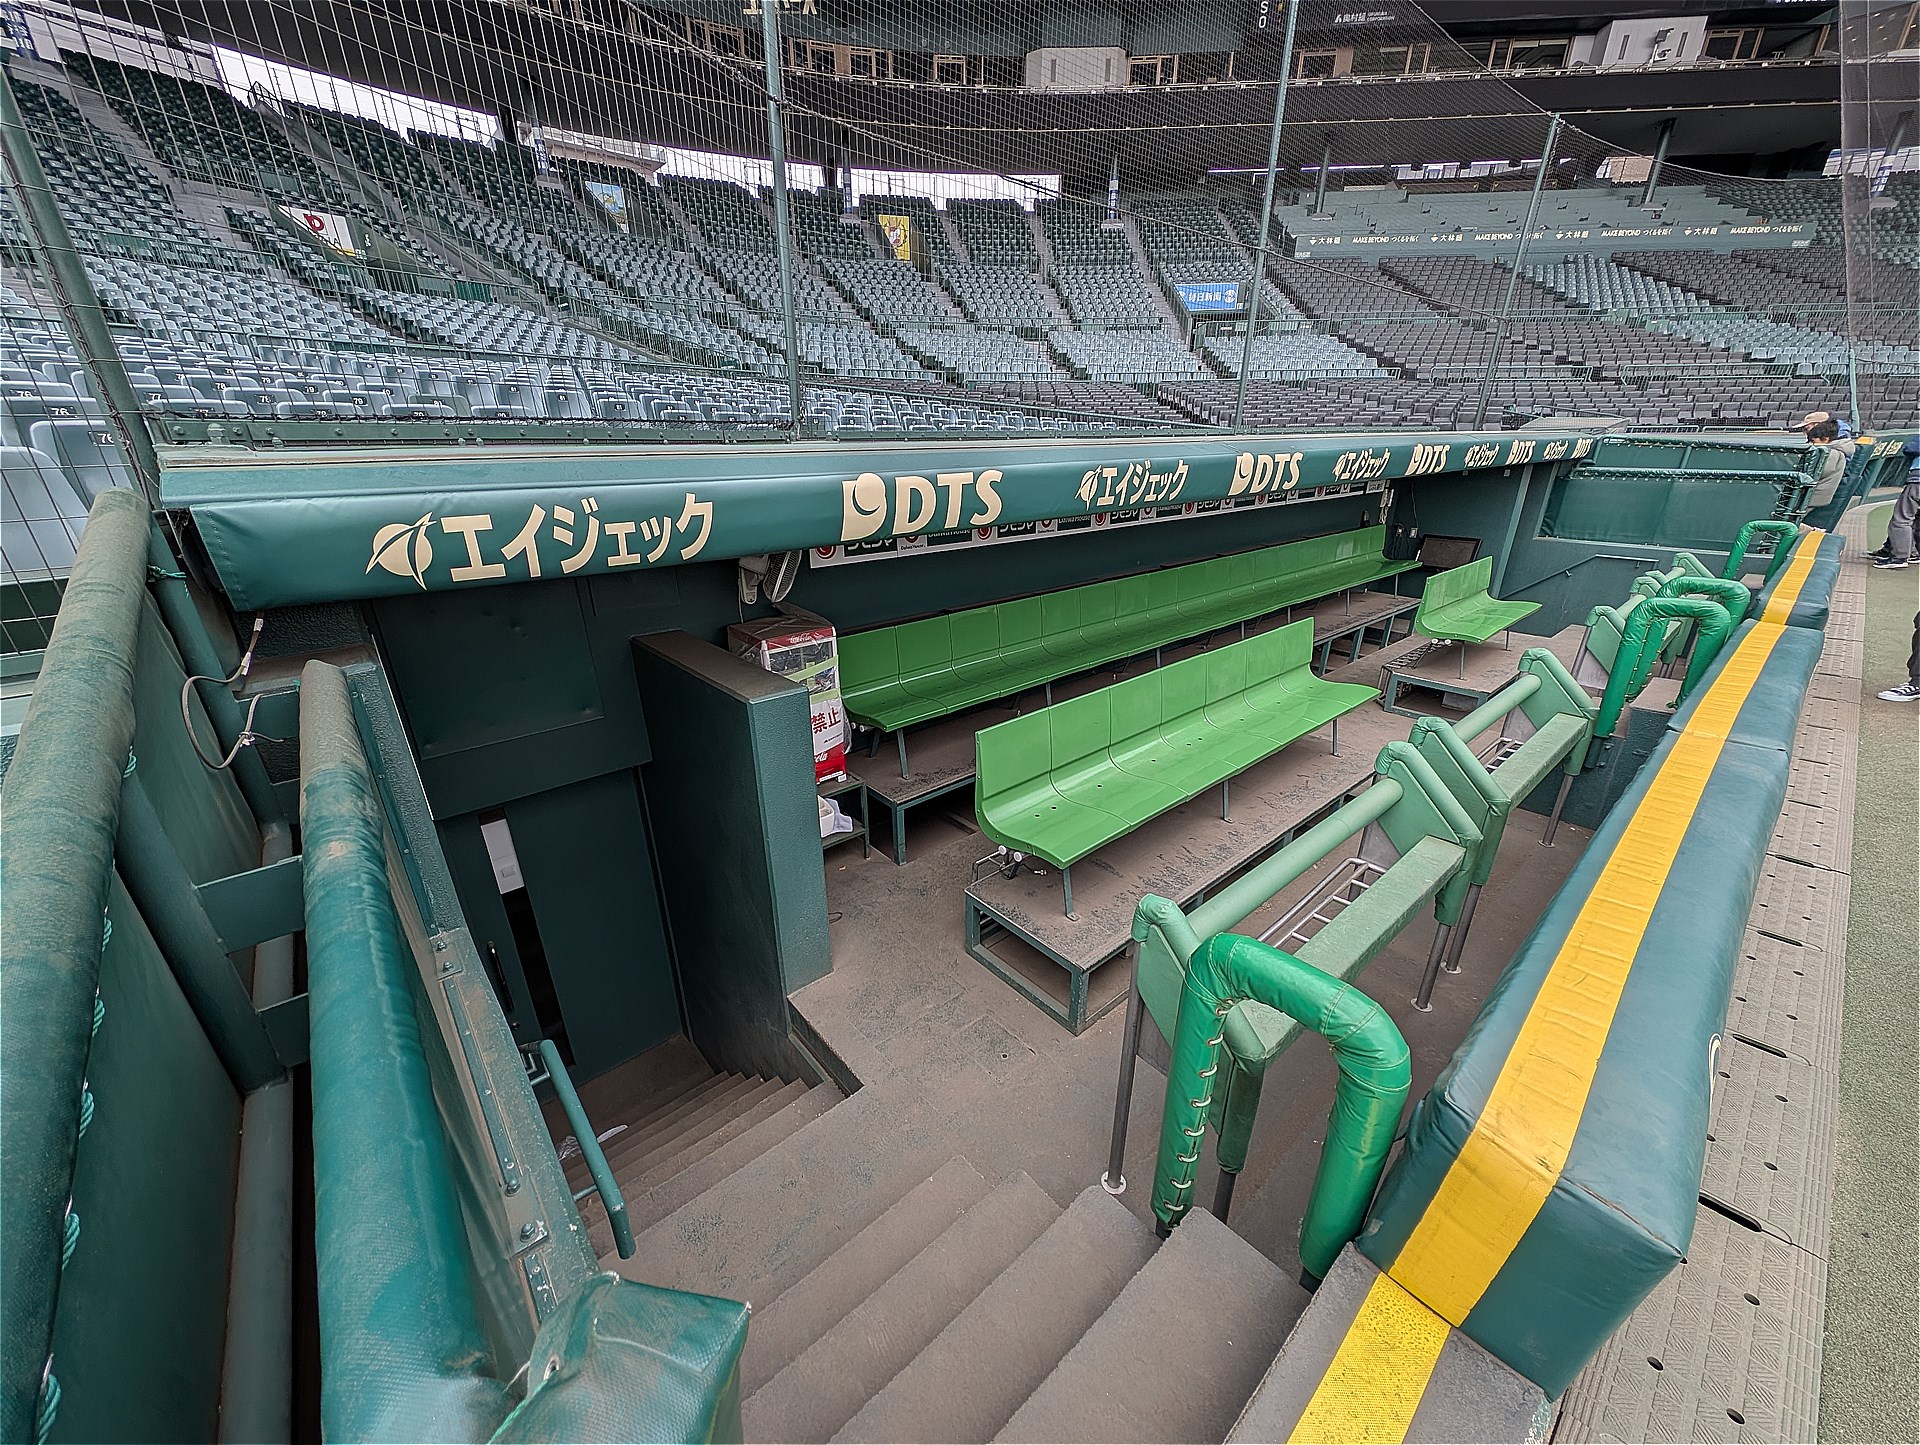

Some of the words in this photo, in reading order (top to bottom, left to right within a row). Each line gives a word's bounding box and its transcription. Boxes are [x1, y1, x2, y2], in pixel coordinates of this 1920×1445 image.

[1318, 236, 1341, 244] 大林組
[1440, 234, 1463, 242] 大林組
[1475, 233, 1491, 241] MAKE
[1565, 230, 1589, 239] 大林組
[1617, 229, 1640, 237] BEYOND
[1693, 227, 1718, 236] 大林組
[1746, 226, 1771, 234] BEYOND
[1339, 448, 1391, 480] エイジェック
[1415, 444, 1451, 475] DTS
[1468, 442, 1500, 468] エイジェック
[1513, 440, 1537, 464] DTS
[1096, 459, 1190, 507] エイジェック
[1249, 452, 1304, 494] DTS
[892, 469, 1004, 535] DTS
[440, 492, 714, 582] エイジェック
[811, 706, 842, 734] 禁止
